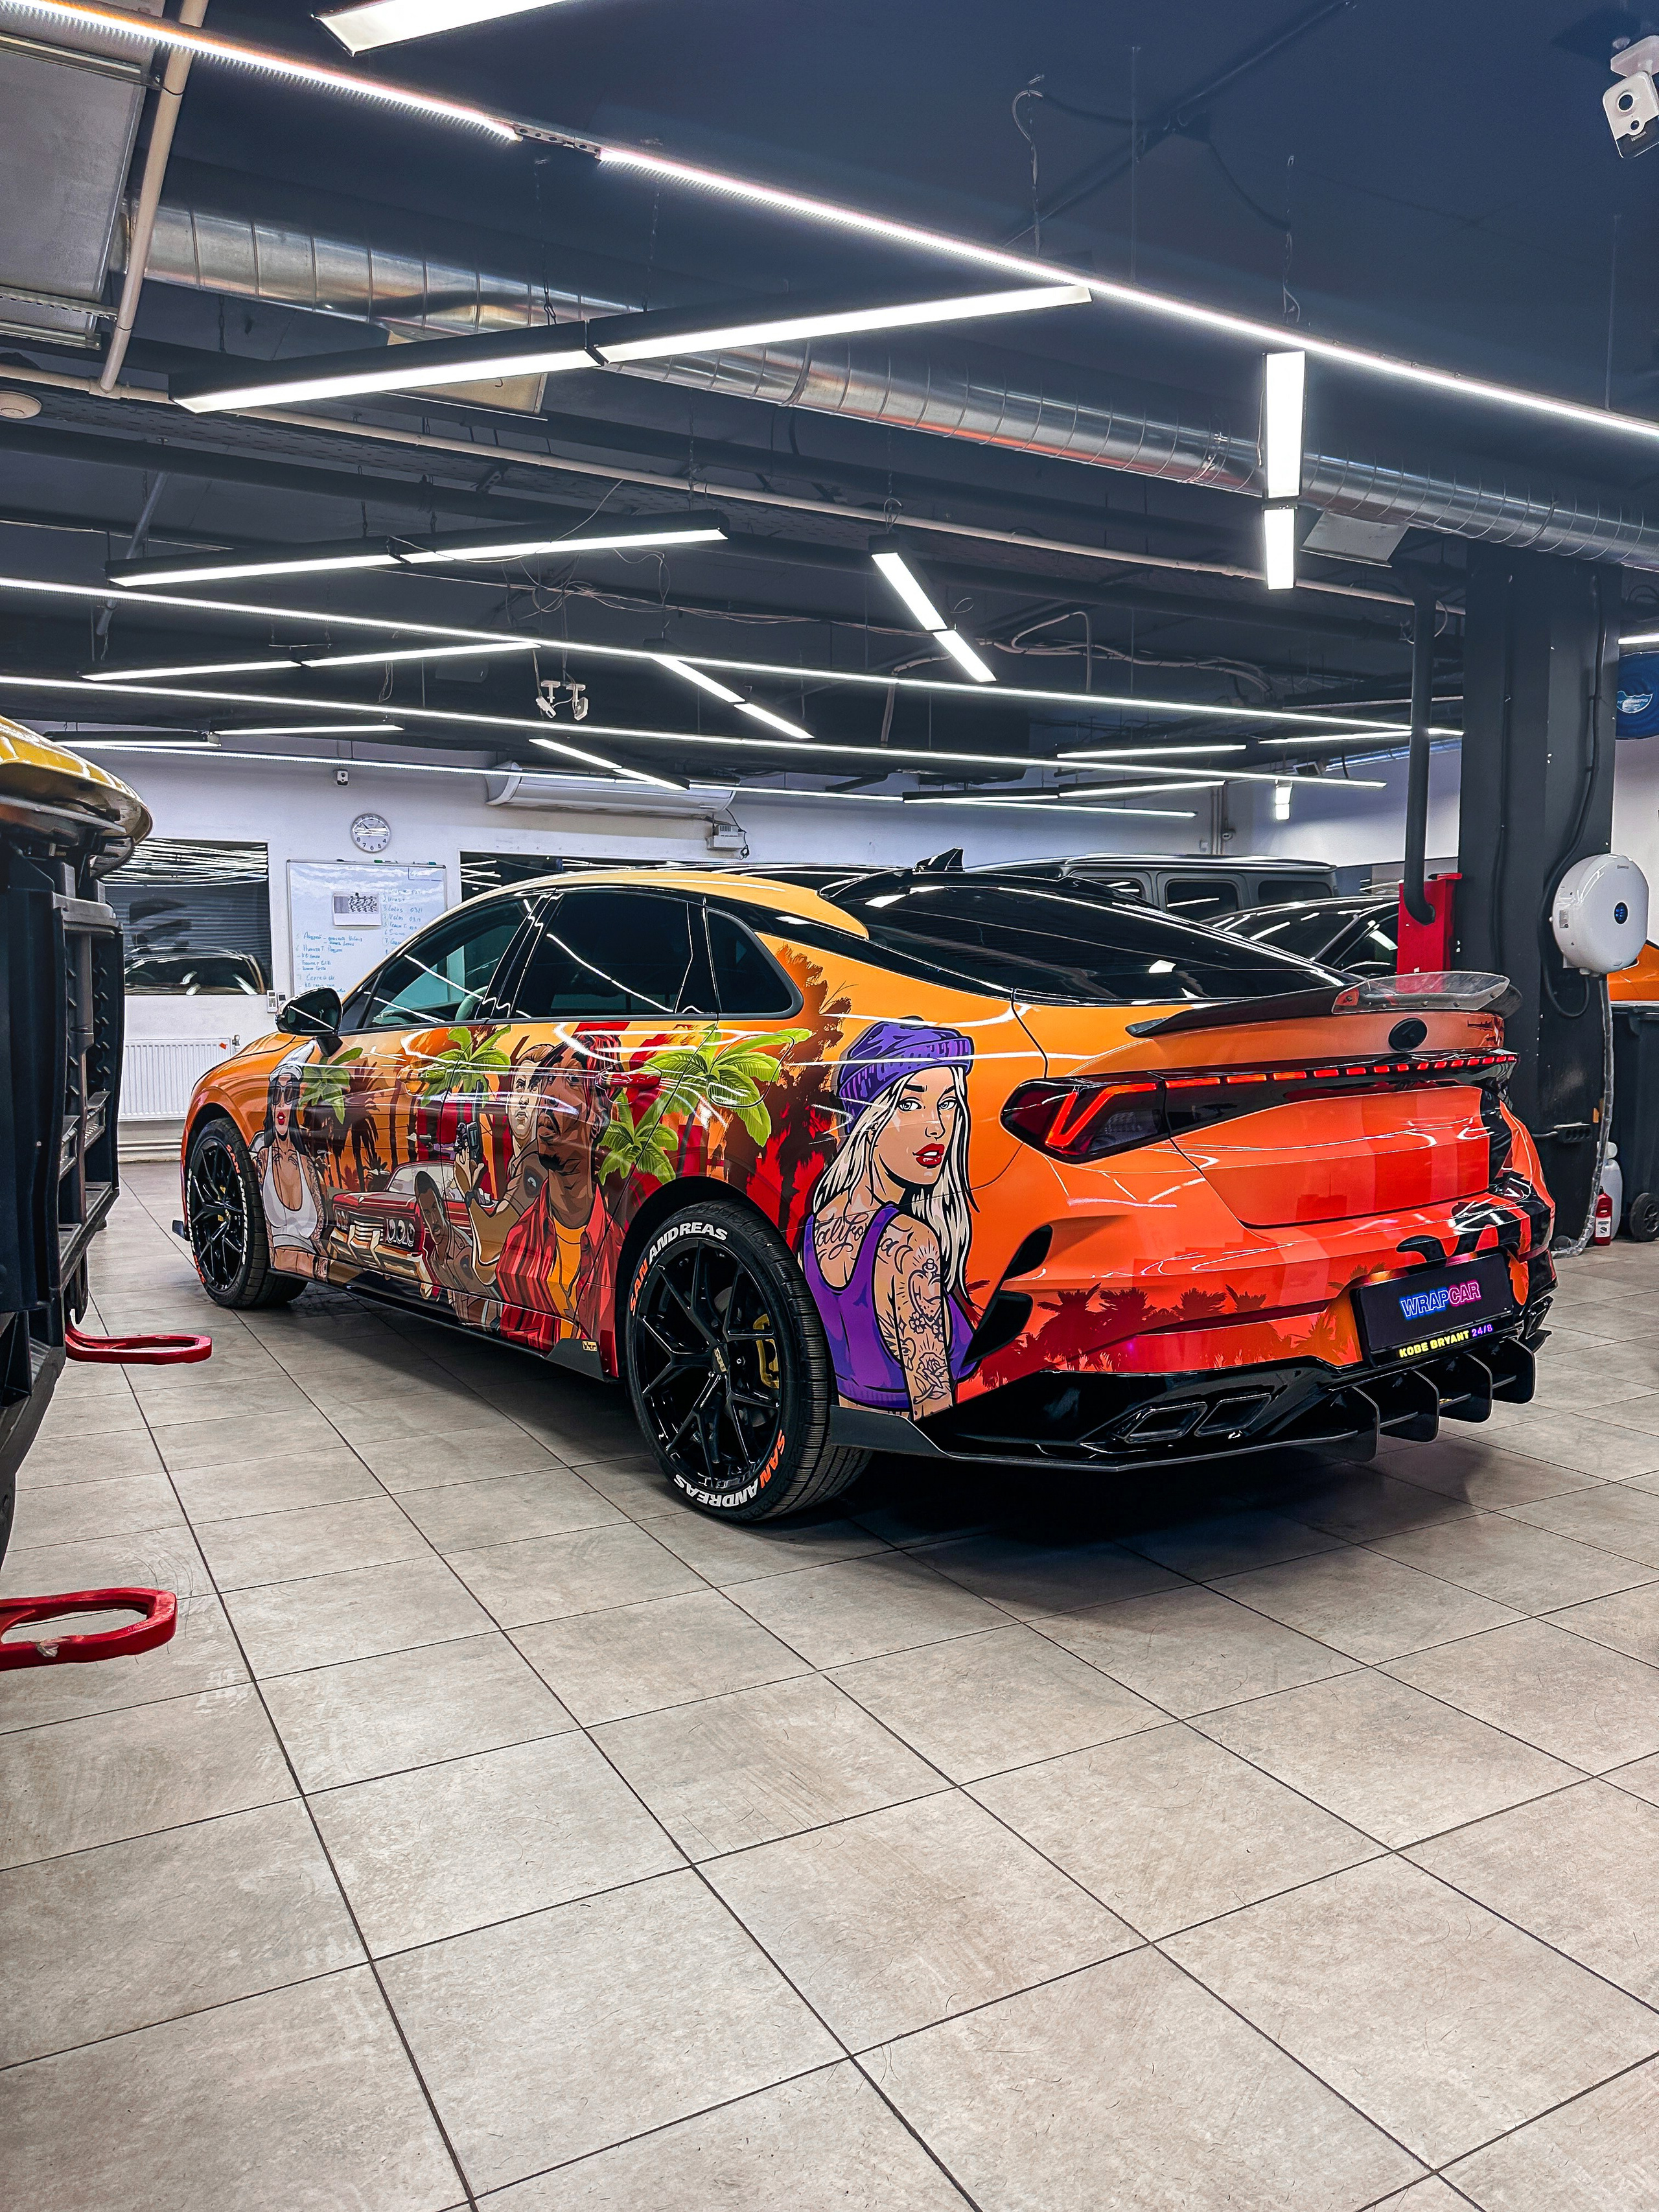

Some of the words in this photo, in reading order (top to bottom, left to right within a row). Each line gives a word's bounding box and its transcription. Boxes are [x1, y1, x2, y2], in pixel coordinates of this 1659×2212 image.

[630, 1257, 649, 1316] SAN
[649, 1222, 728, 1265] ANDREAS
[1399, 1281, 1482, 1318] WRAPCAR
[1398, 1342, 1430, 1358] KOBE
[1430, 1330, 1470, 1349] BRYANT
[1471, 1323, 1493, 1338] 24/8
[760, 1428, 785, 1489] SAN
[673, 1474, 759, 1508] ANDREAS
